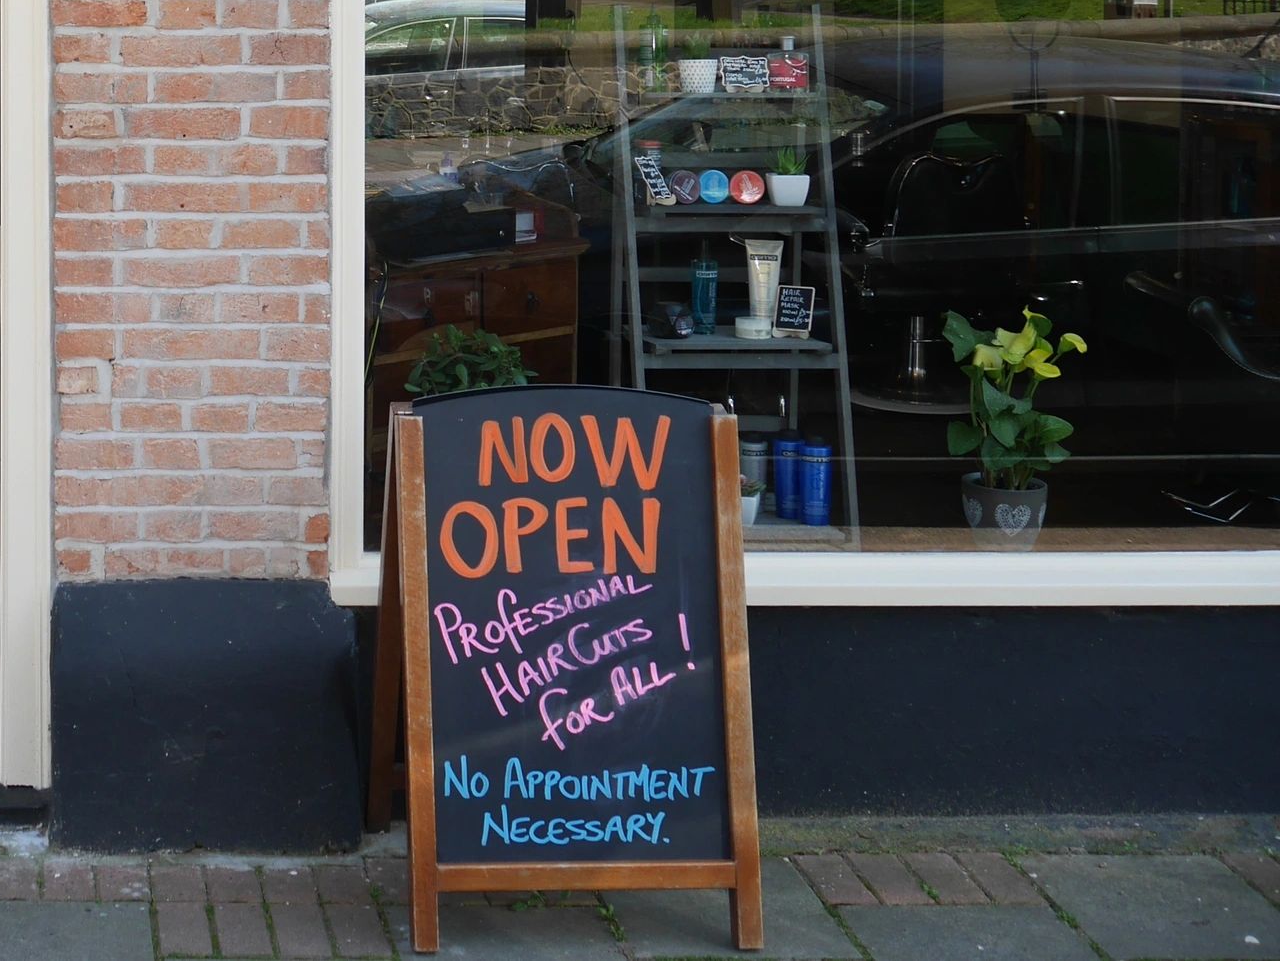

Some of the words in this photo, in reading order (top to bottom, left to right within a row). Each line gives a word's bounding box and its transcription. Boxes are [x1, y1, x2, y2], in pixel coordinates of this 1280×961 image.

[783, 288, 801, 297] HAIR
[480, 414, 669, 491] NOW
[440, 498, 660, 579] OPEN
[443, 755, 490, 800] No
[503, 756, 716, 803] APPOINTMENT
